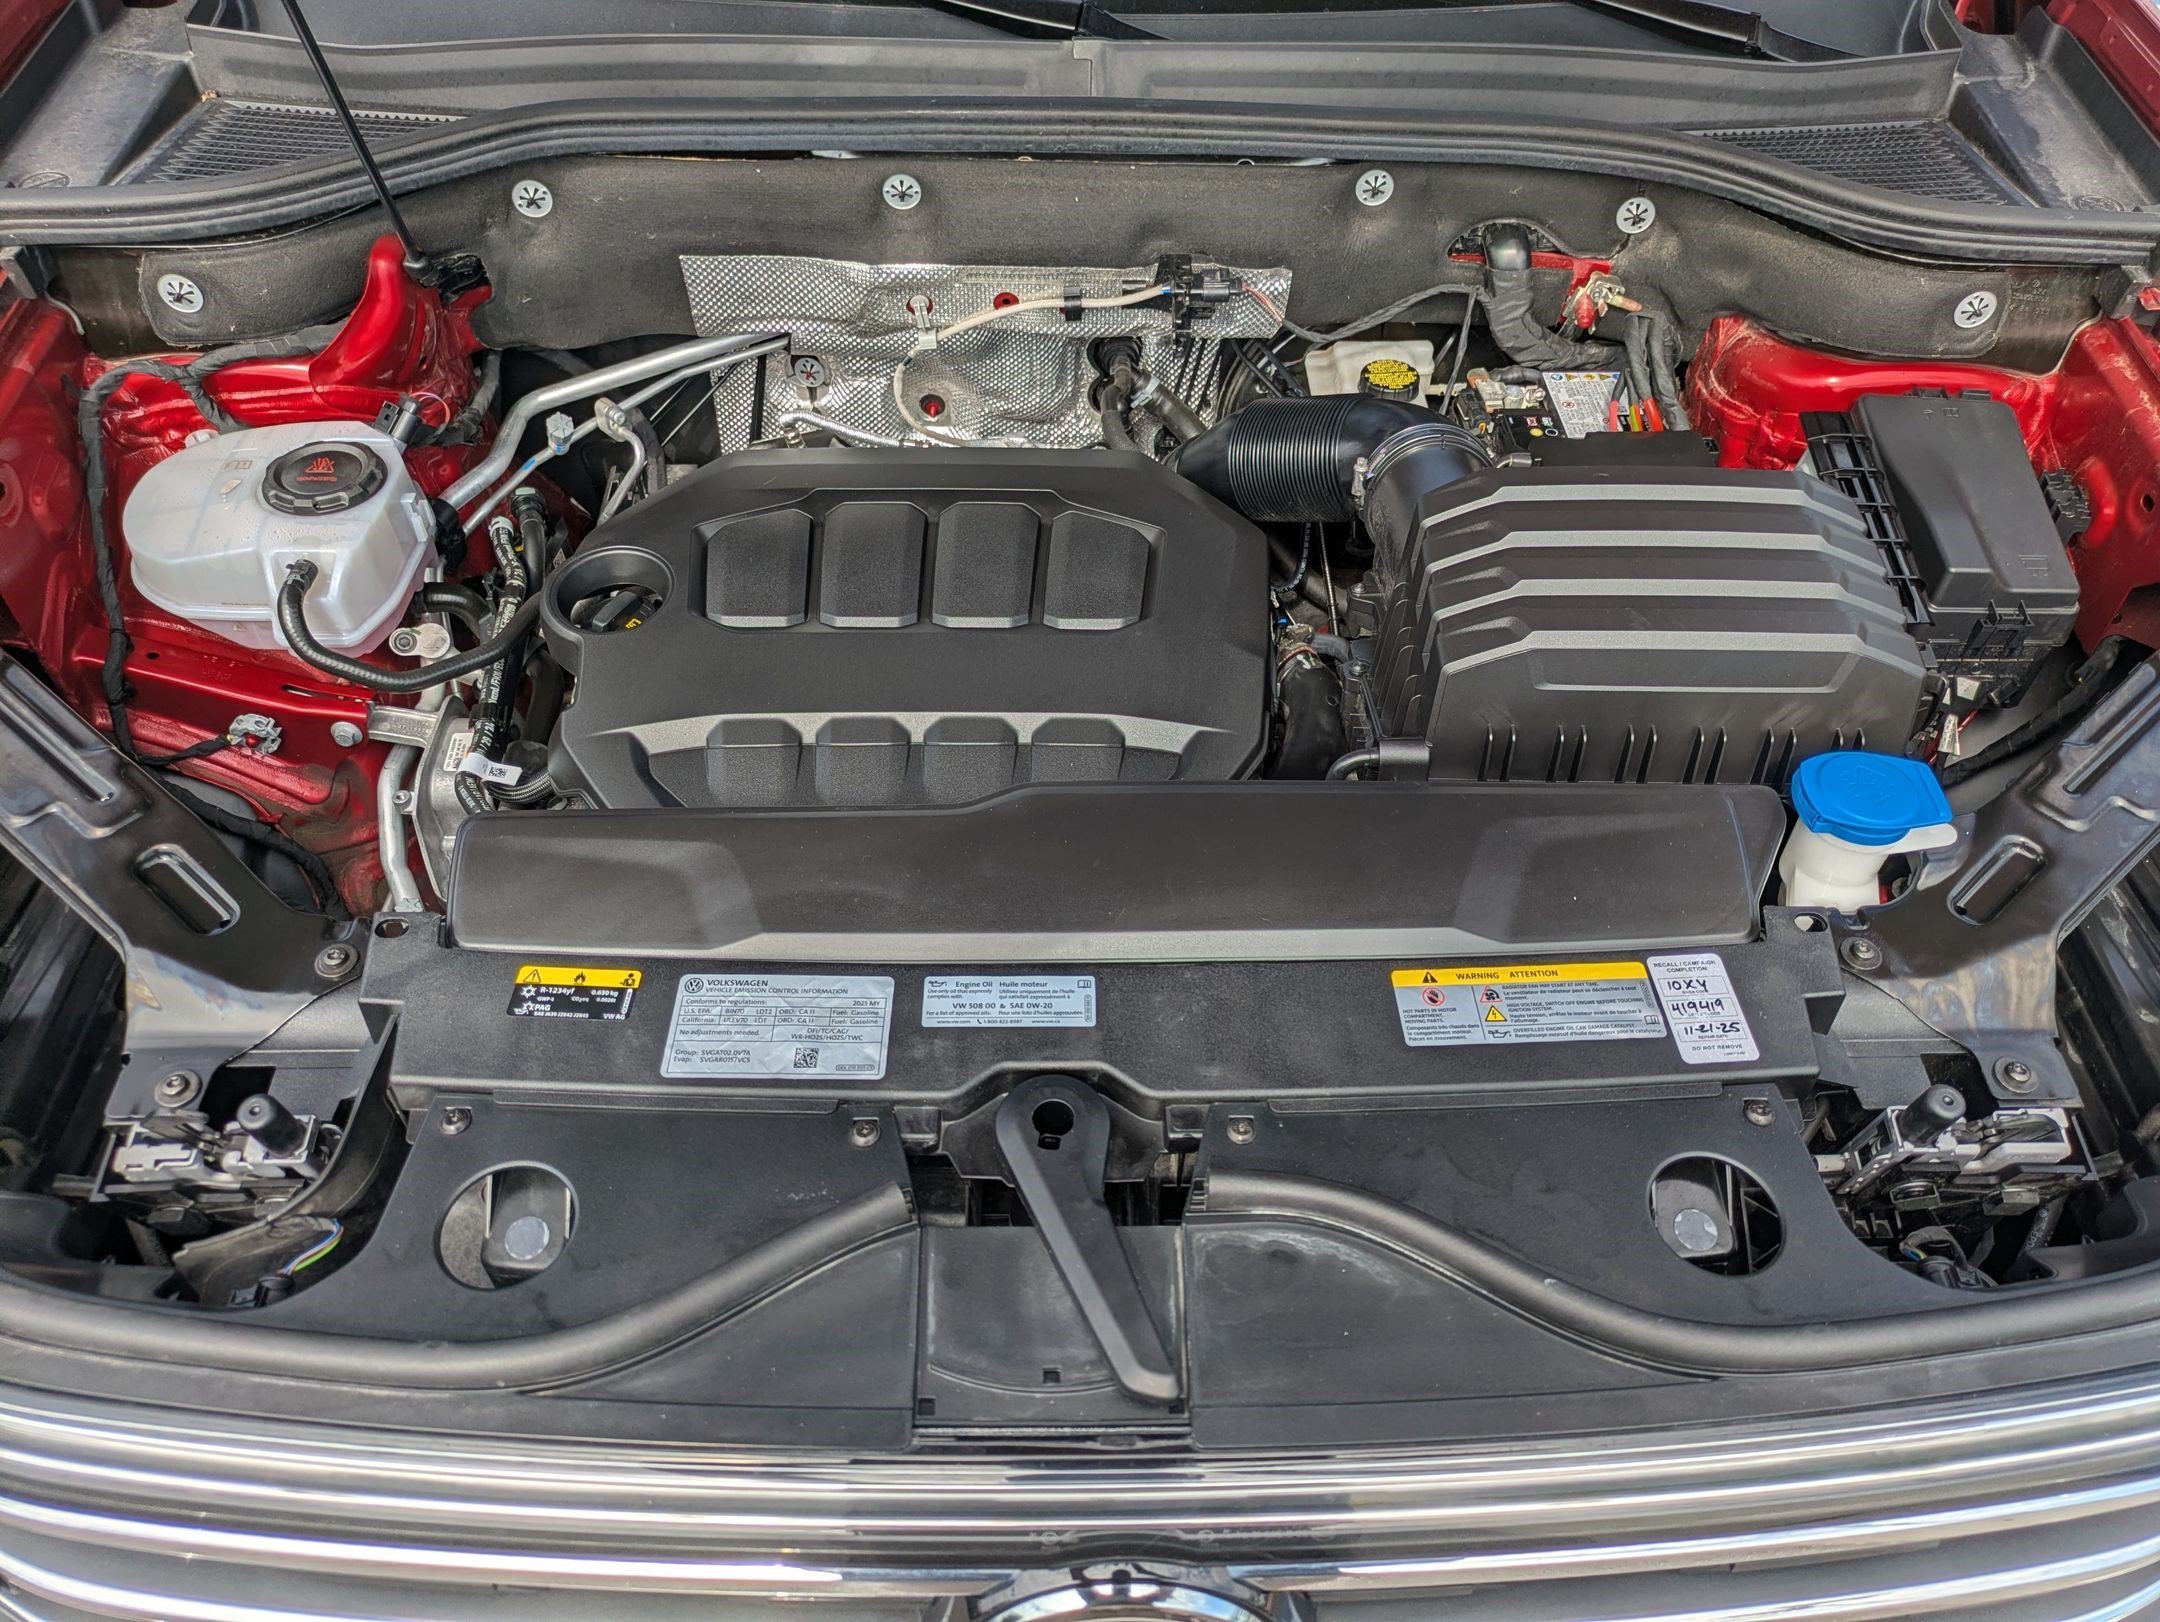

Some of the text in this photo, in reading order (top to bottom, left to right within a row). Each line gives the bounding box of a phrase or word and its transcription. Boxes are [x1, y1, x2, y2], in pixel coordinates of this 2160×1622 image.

[1456, 970, 1558, 980] WARNING ATTENTION
[956, 981, 980, 990] Engine
